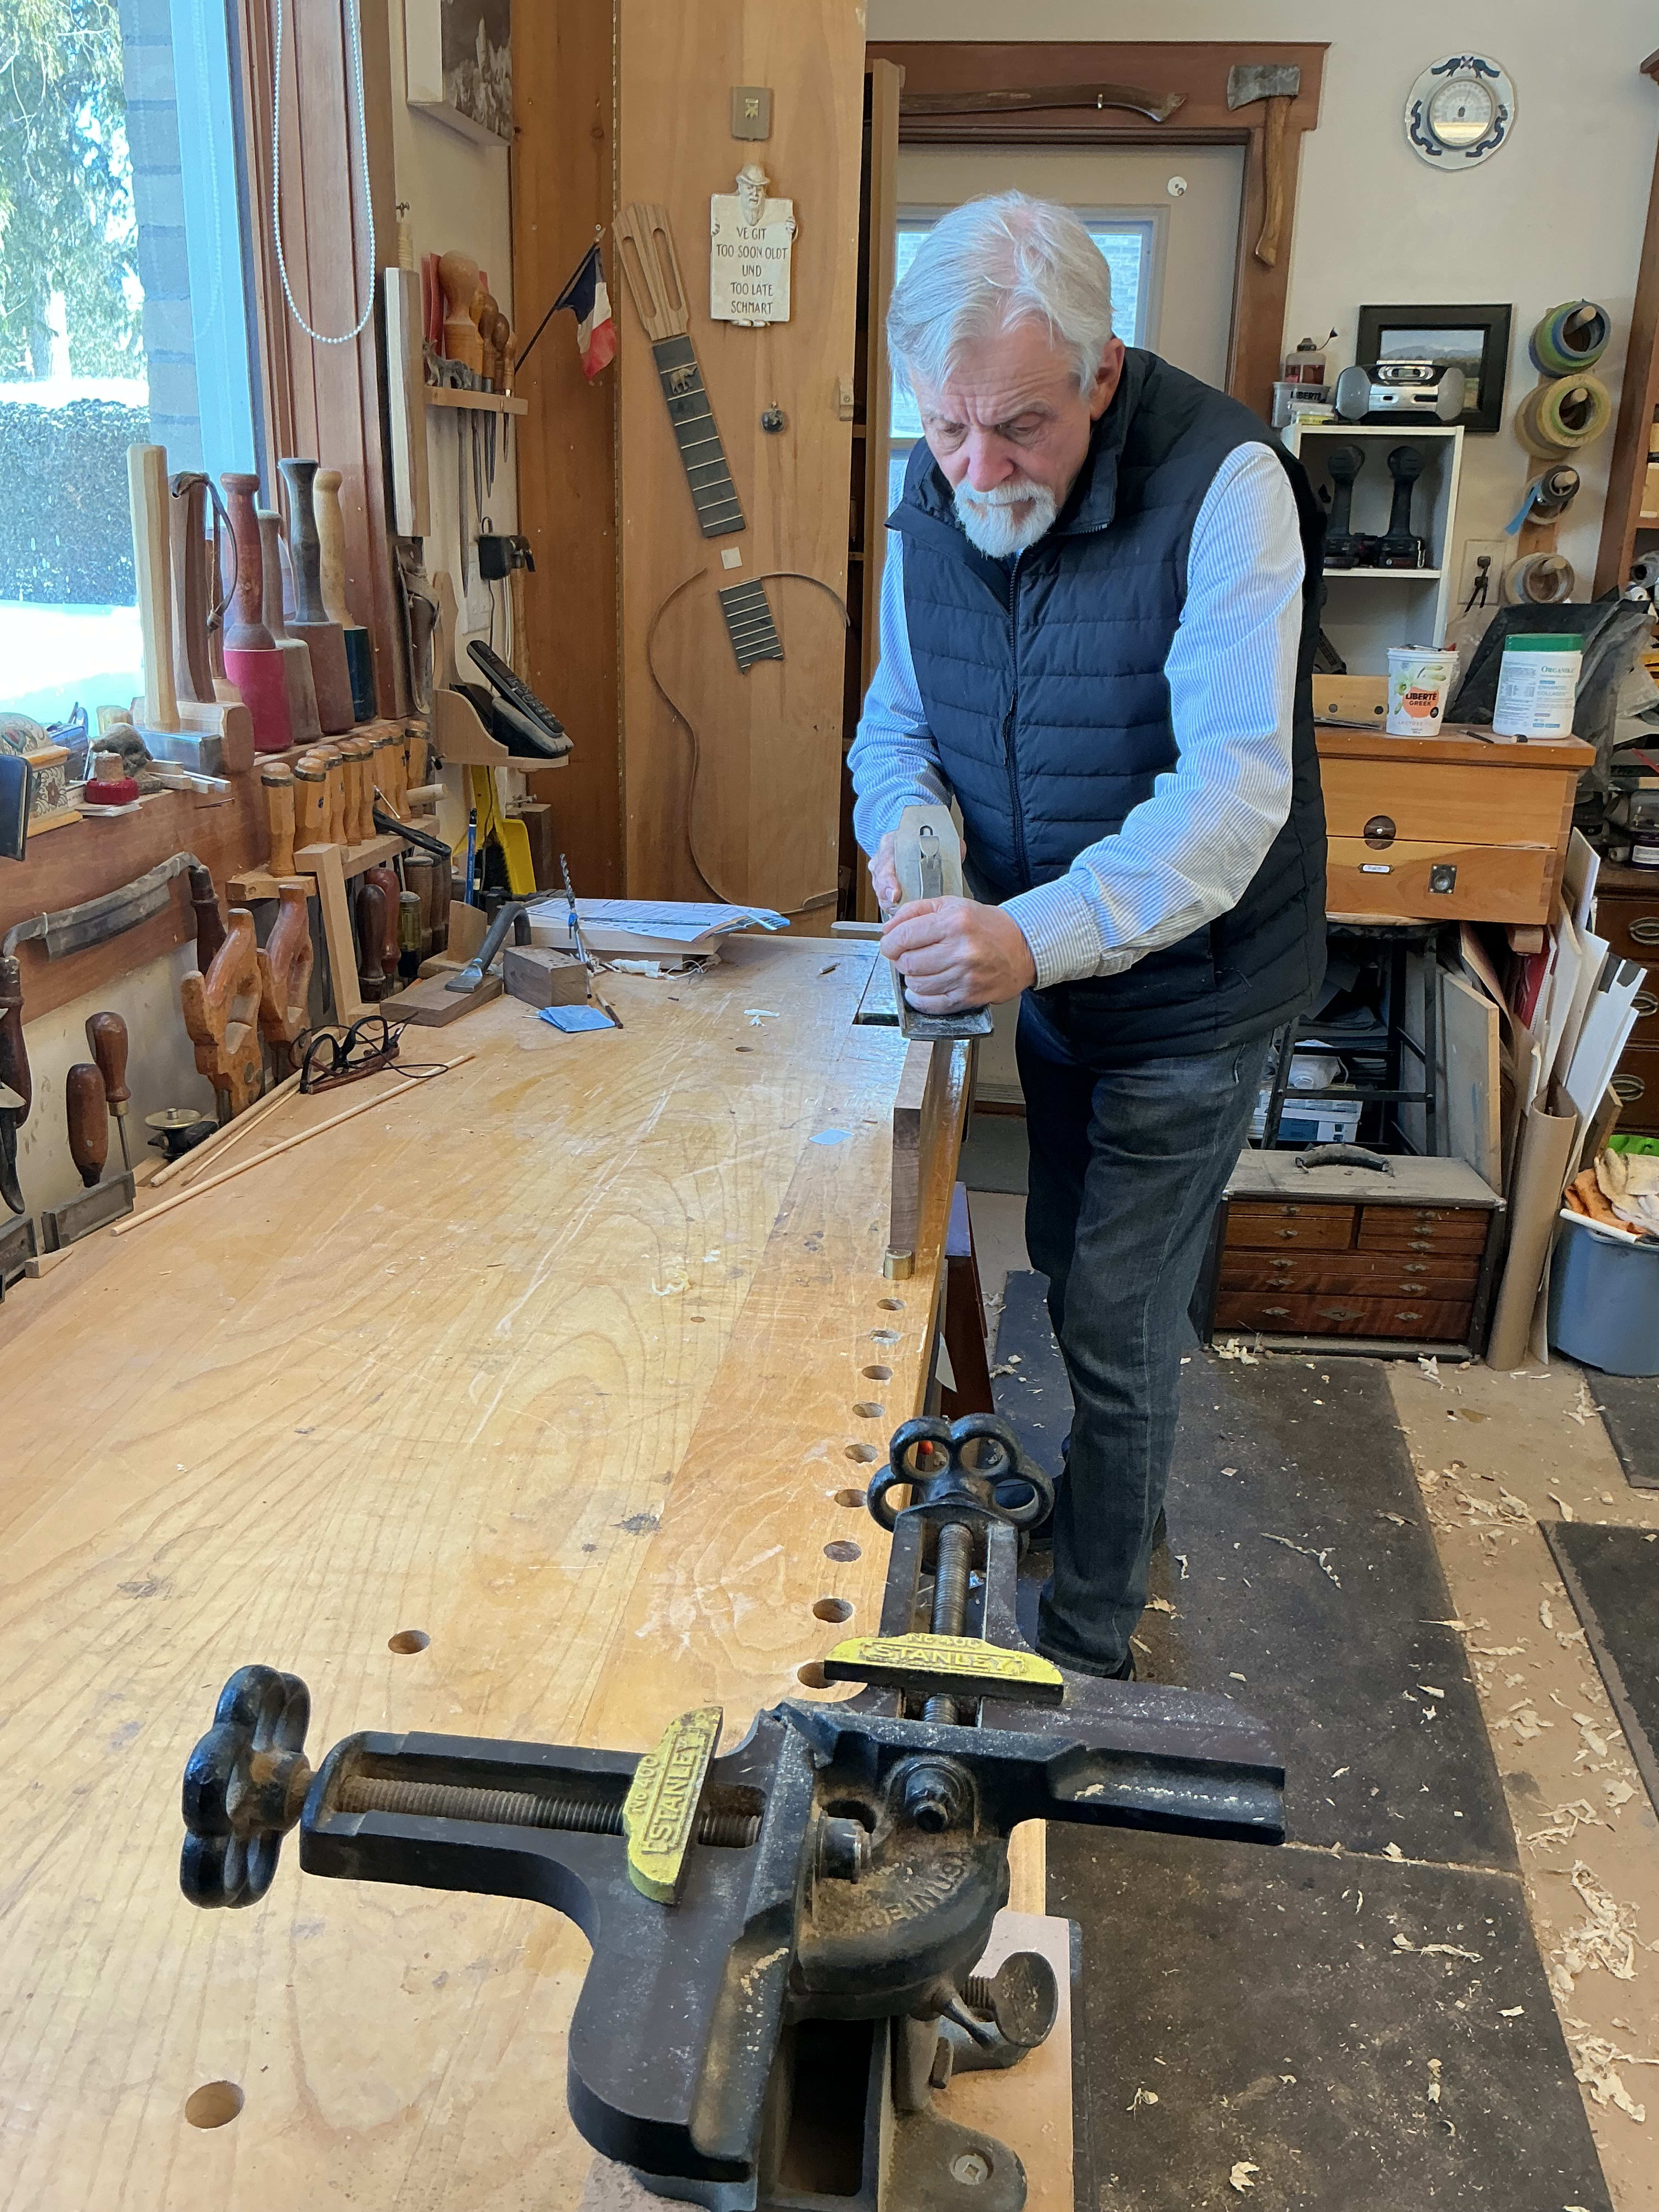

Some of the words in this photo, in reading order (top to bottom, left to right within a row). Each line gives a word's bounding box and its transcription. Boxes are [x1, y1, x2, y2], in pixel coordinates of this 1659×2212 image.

[736, 227, 749, 240] VE
[752, 228, 767, 240] GIT
[716, 244, 735, 258] TOO
[737, 245, 763, 258] SOON
[765, 247, 788, 260] OLDT
[742, 264, 762, 277] UND
[730, 281, 749, 295] TOO
[752, 283, 774, 297] LATE
[731, 301, 773, 315] SCHMART
[876, 1645, 1017, 1672] STANLEY
[650, 1741, 700, 1842] STANLEY
